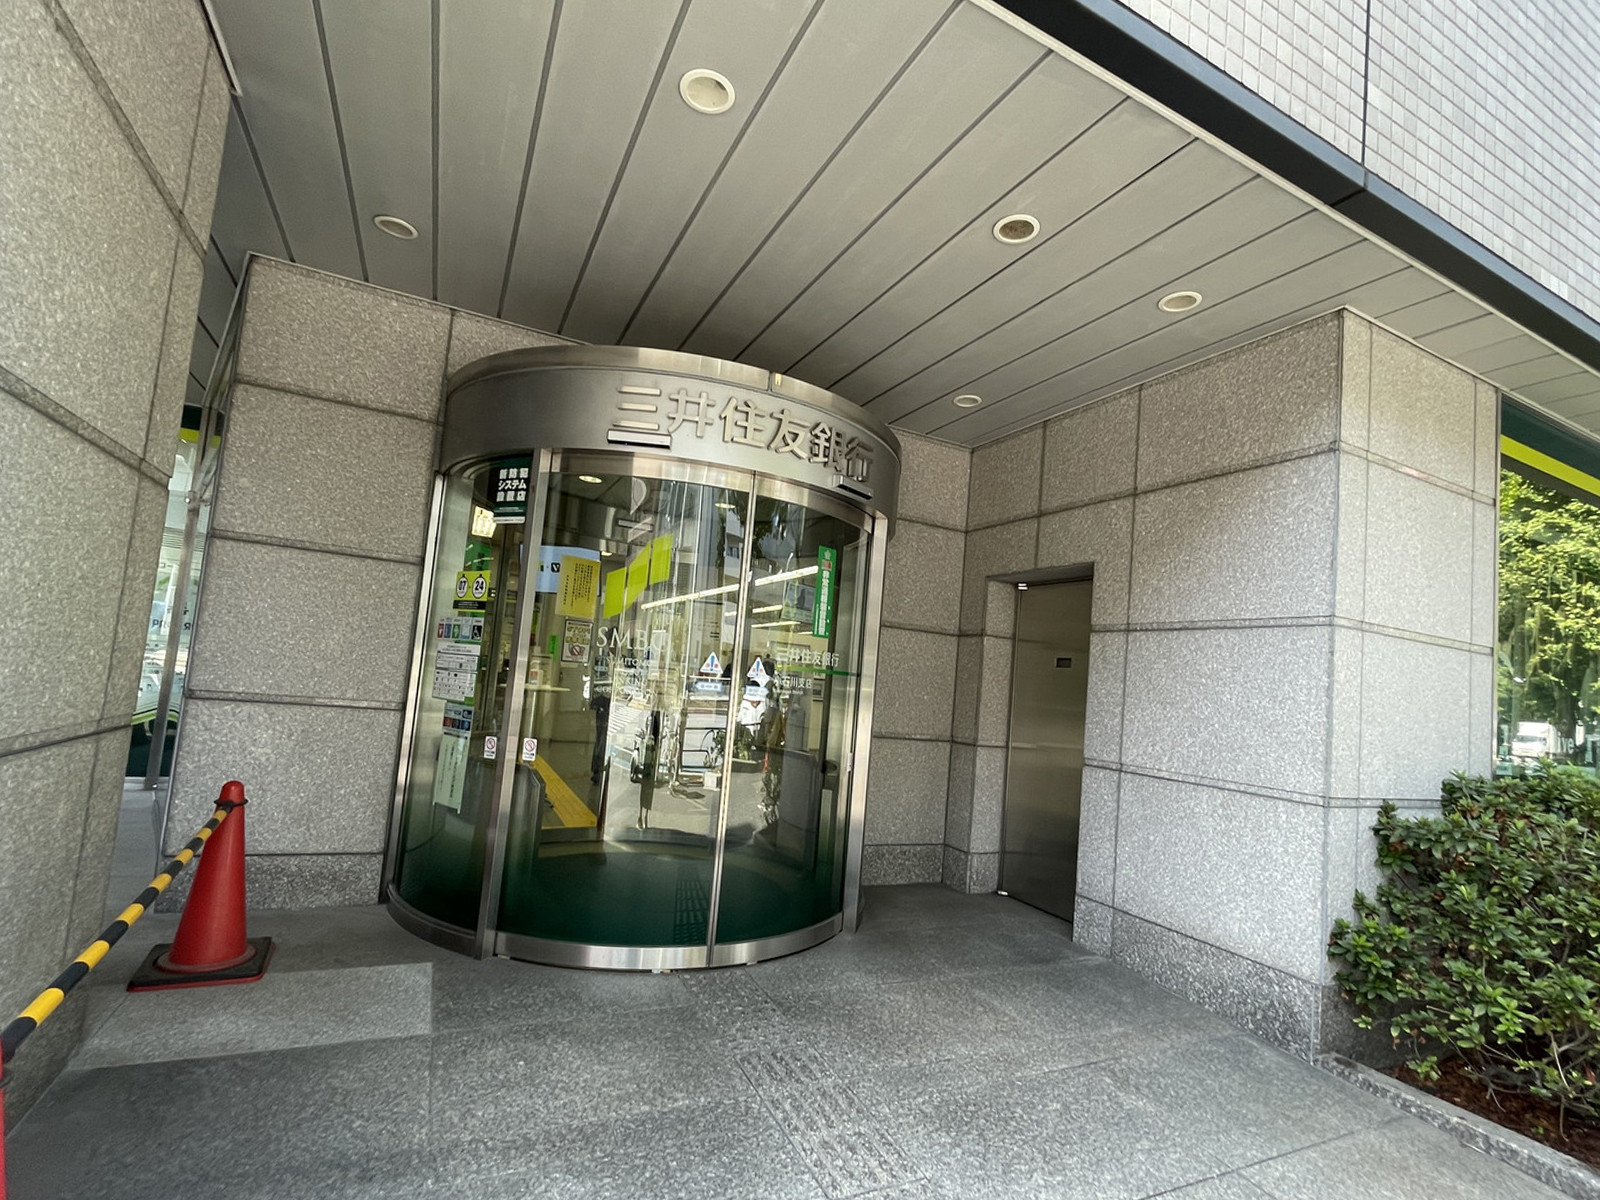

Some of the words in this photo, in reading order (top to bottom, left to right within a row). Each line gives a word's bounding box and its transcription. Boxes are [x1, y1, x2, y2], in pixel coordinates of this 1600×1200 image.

[612, 385, 874, 483] 三井住友銀行
[498, 479, 527, 490] システム
[474, 580, 484, 591] 24
[776, 647, 839, 667] 三井住友銀行
